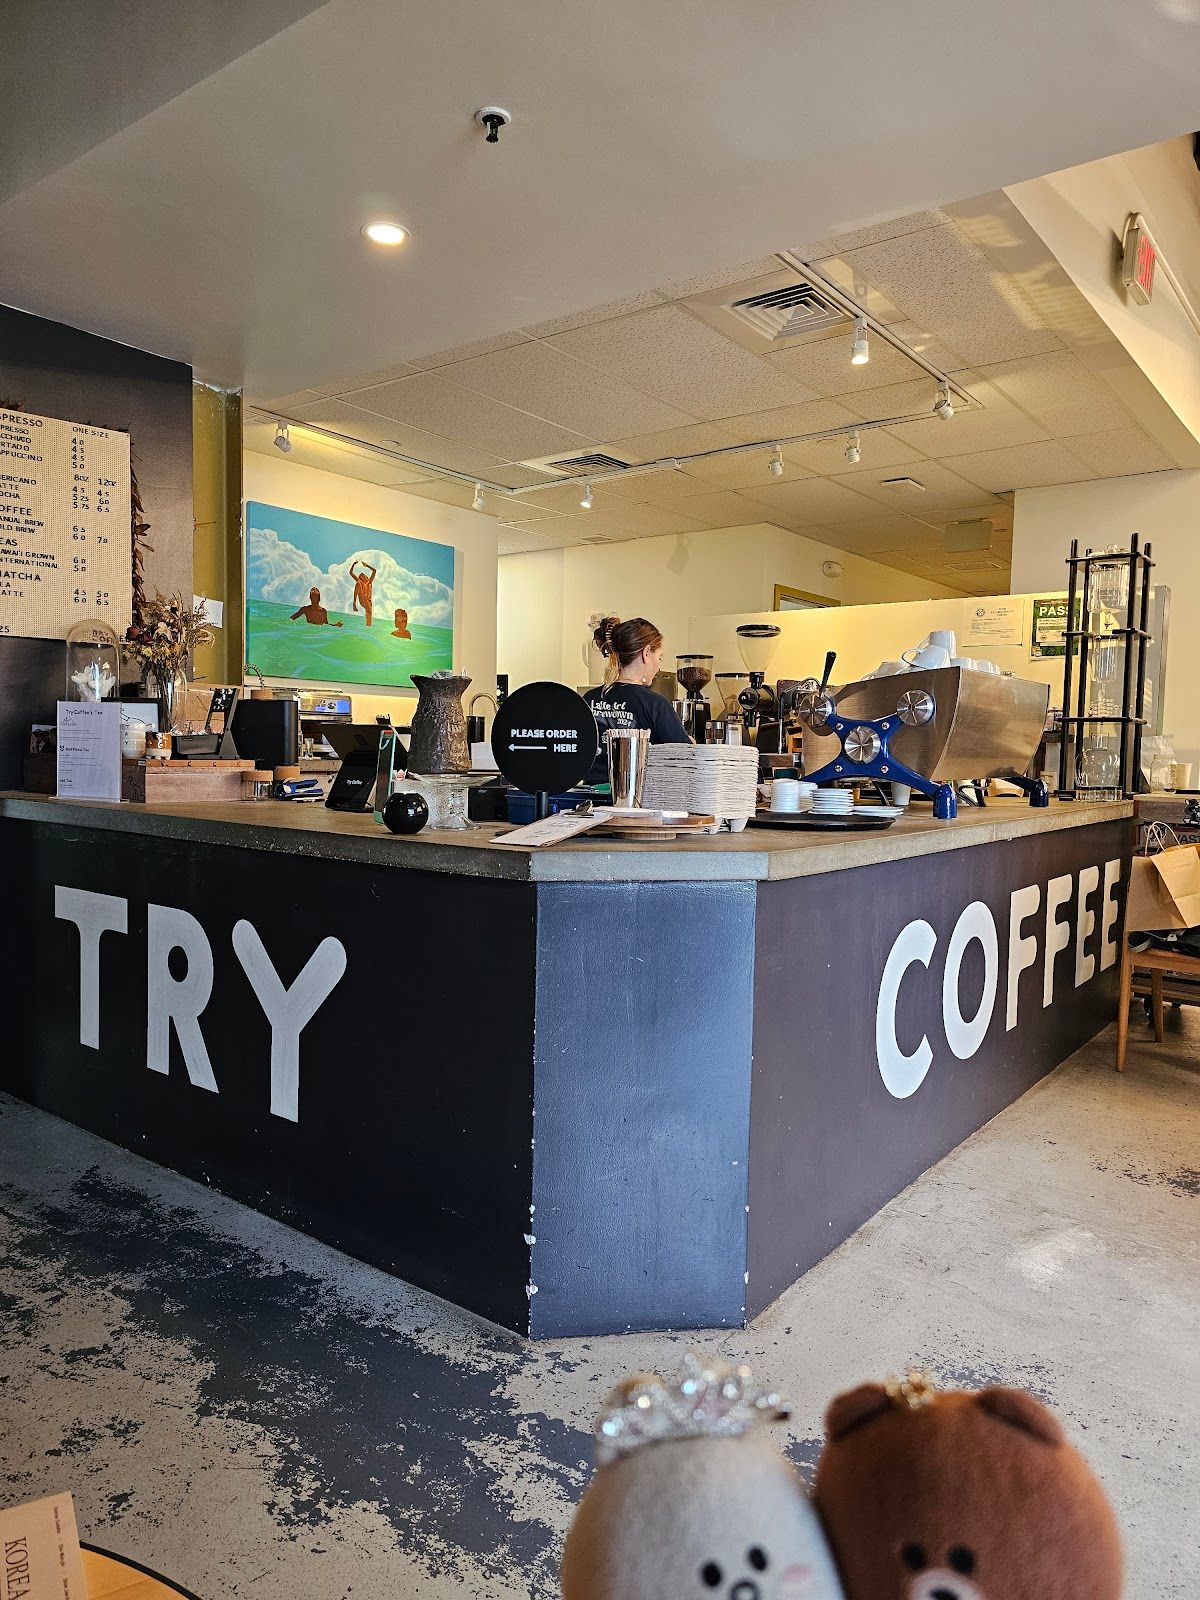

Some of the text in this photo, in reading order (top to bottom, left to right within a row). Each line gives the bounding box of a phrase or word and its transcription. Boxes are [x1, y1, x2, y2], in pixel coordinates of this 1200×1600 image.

[0, 413, 43, 428] PRESSO
[72, 426, 110, 439] ONE SIZE
[0, 474, 37, 486] ERICANO
[0, 570, 42, 582] ATCHA
[1039, 605, 1069, 617] PAS
[510, 728, 578, 739] PLEASE ORDER
[553, 743, 578, 753] HERE
[876, 859, 1120, 1099] COFFEE
[55, 885, 347, 1123] TRY
